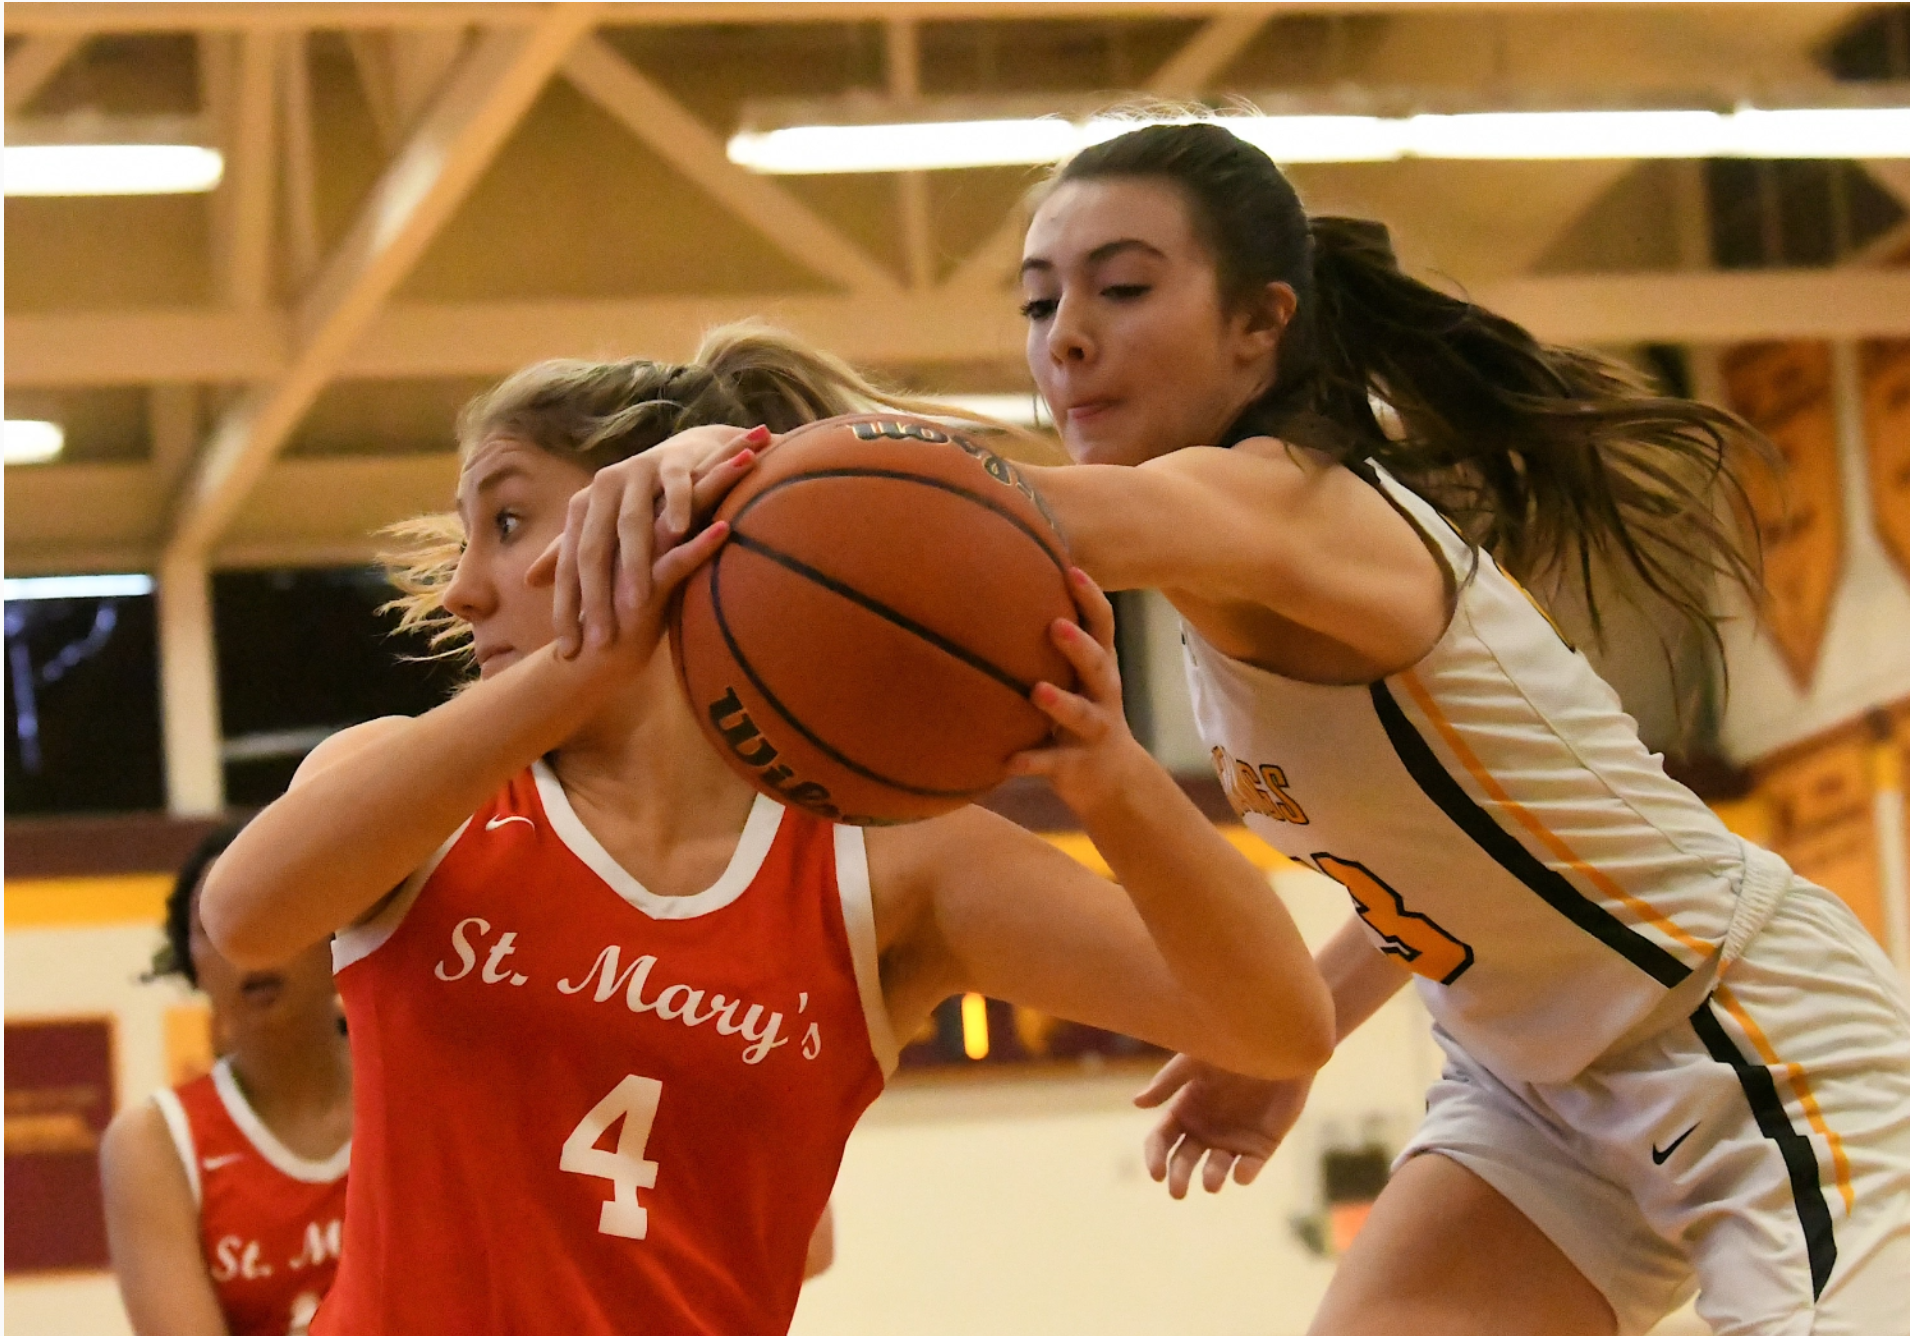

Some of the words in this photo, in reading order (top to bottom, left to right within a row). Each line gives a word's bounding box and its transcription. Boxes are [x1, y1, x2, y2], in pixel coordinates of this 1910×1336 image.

[433, 917, 529, 986] St.
[556, 944, 822, 1065] Mary's
[559, 1073, 663, 1240] 4
